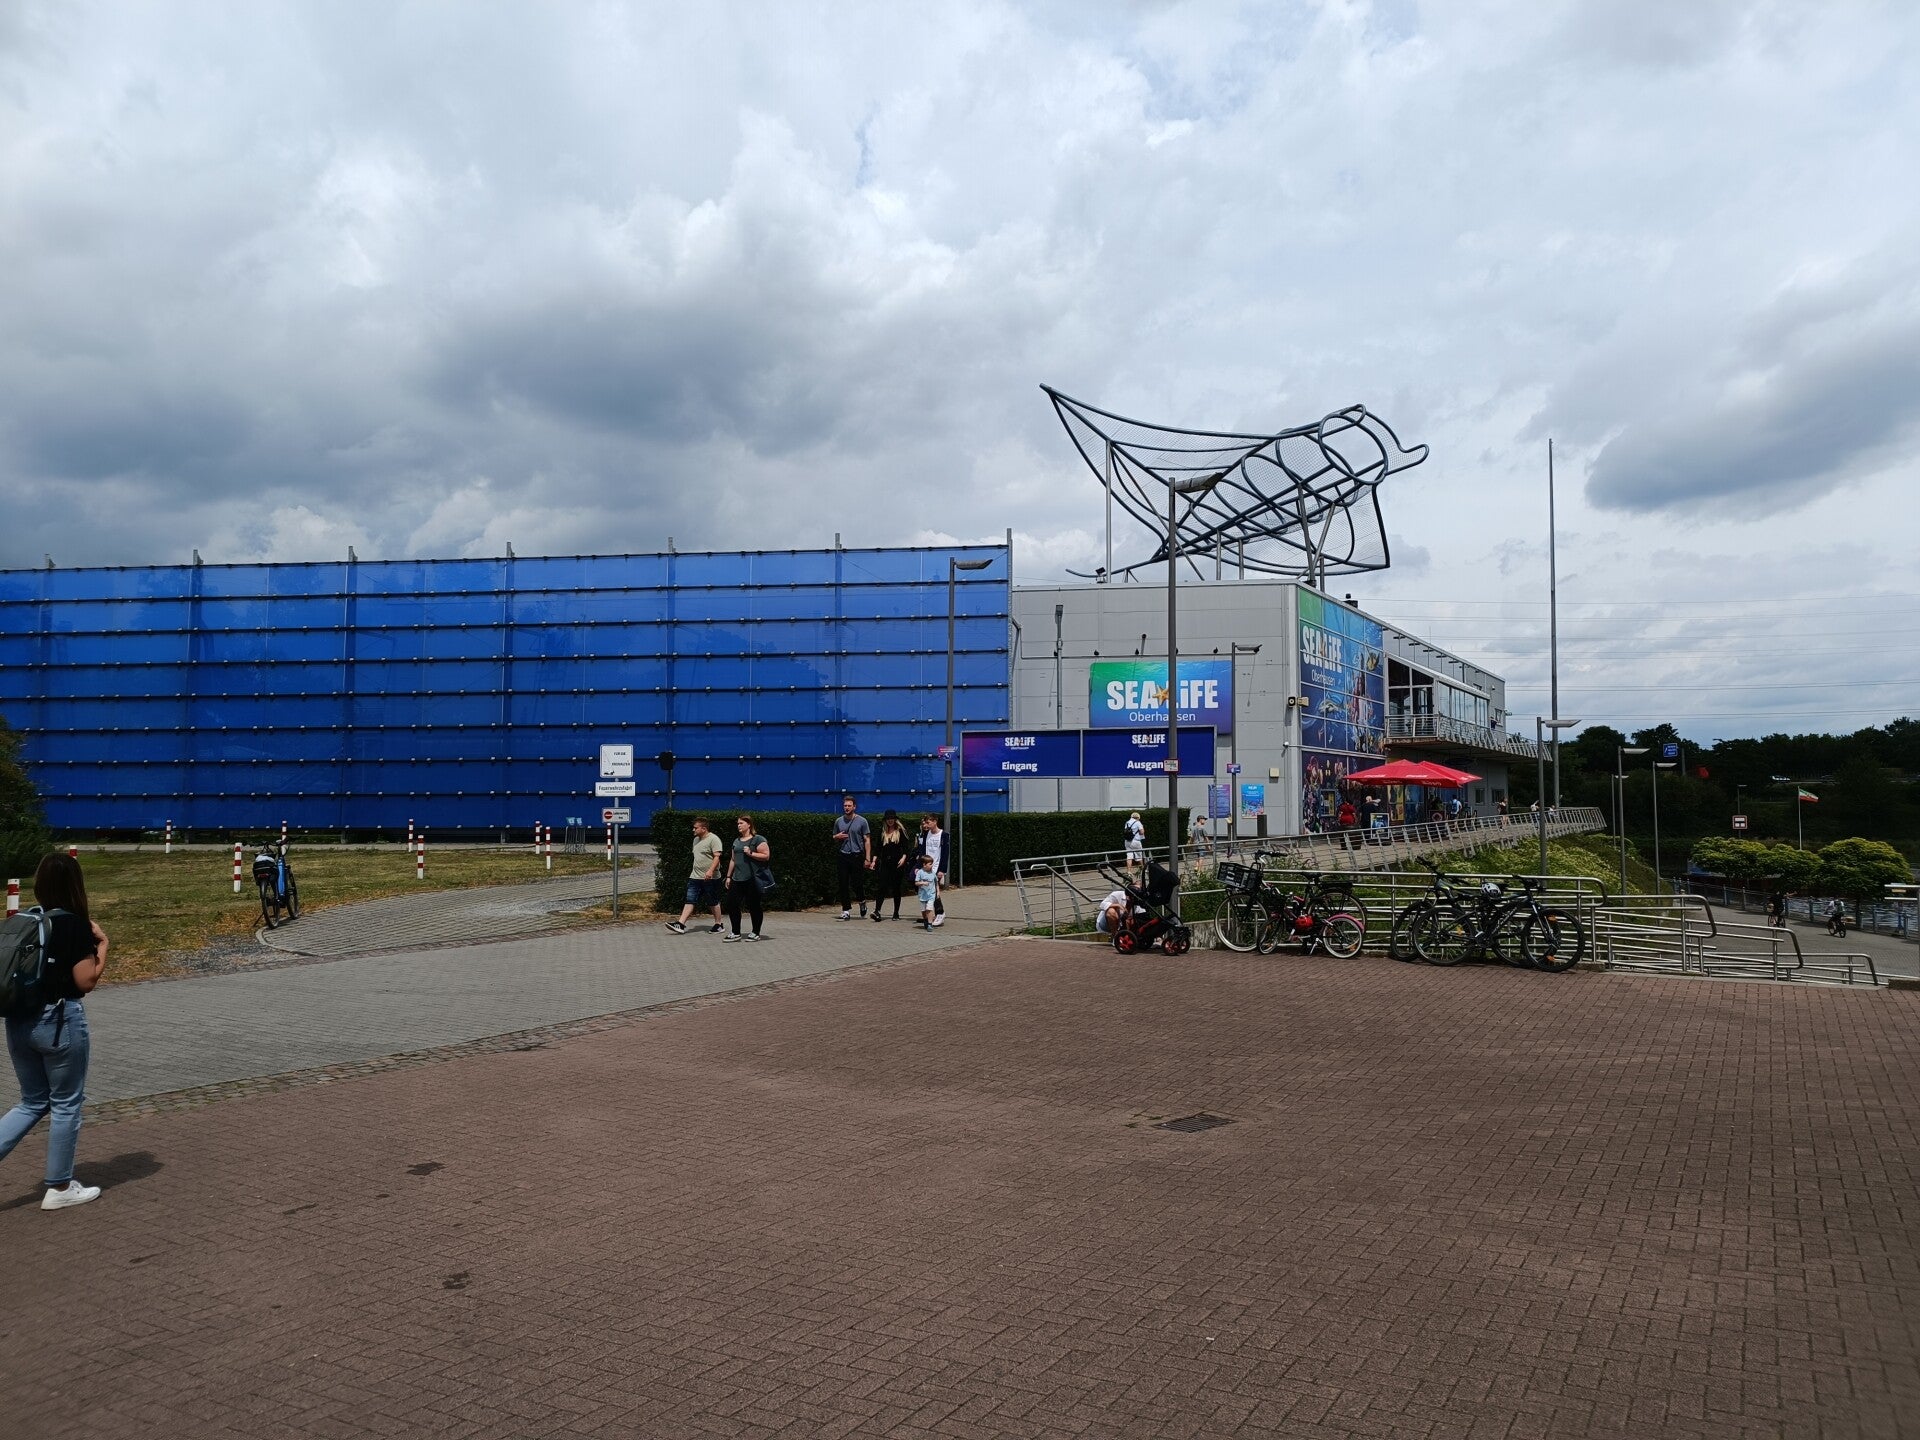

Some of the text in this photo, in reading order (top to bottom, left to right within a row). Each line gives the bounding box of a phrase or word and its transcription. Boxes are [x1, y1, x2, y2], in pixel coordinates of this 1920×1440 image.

[1129, 712, 1196, 722] Oberhasen
[1002, 760, 1038, 772] Eingang
[1126, 760, 1164, 771] Ausgan
